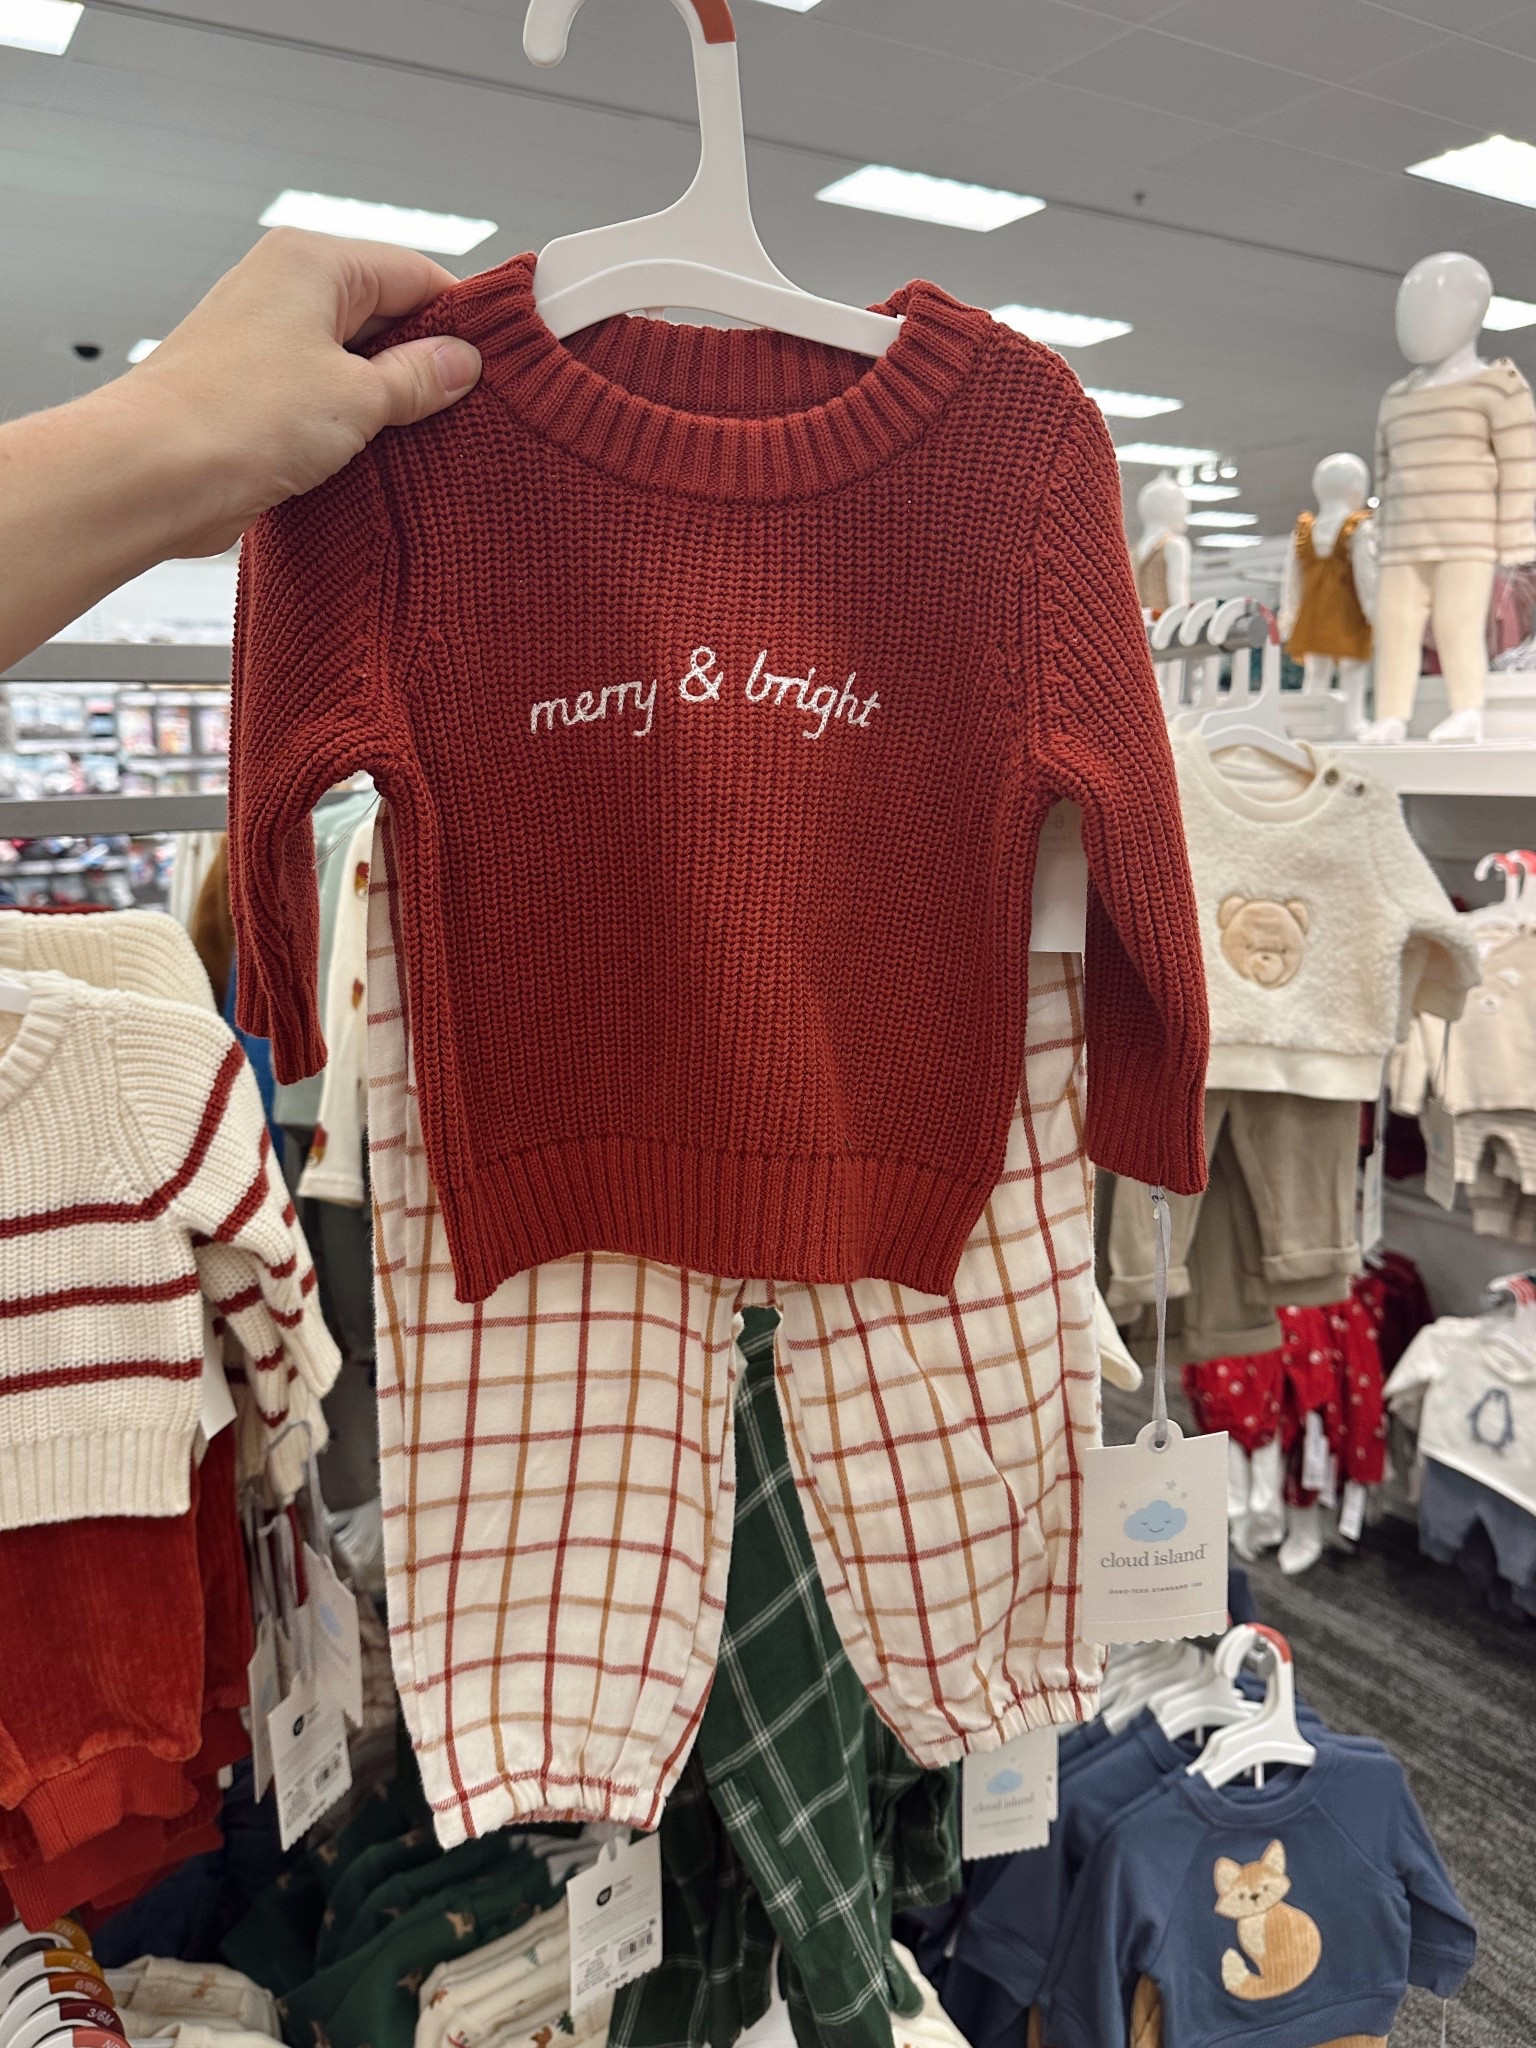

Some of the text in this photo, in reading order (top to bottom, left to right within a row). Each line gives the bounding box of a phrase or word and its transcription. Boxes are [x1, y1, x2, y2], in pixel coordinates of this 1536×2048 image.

[530, 645, 881, 740] merry & bright
[1100, 1544, 1206, 1568] cloud island
[86, 2008, 115, 2027] 3/6M
